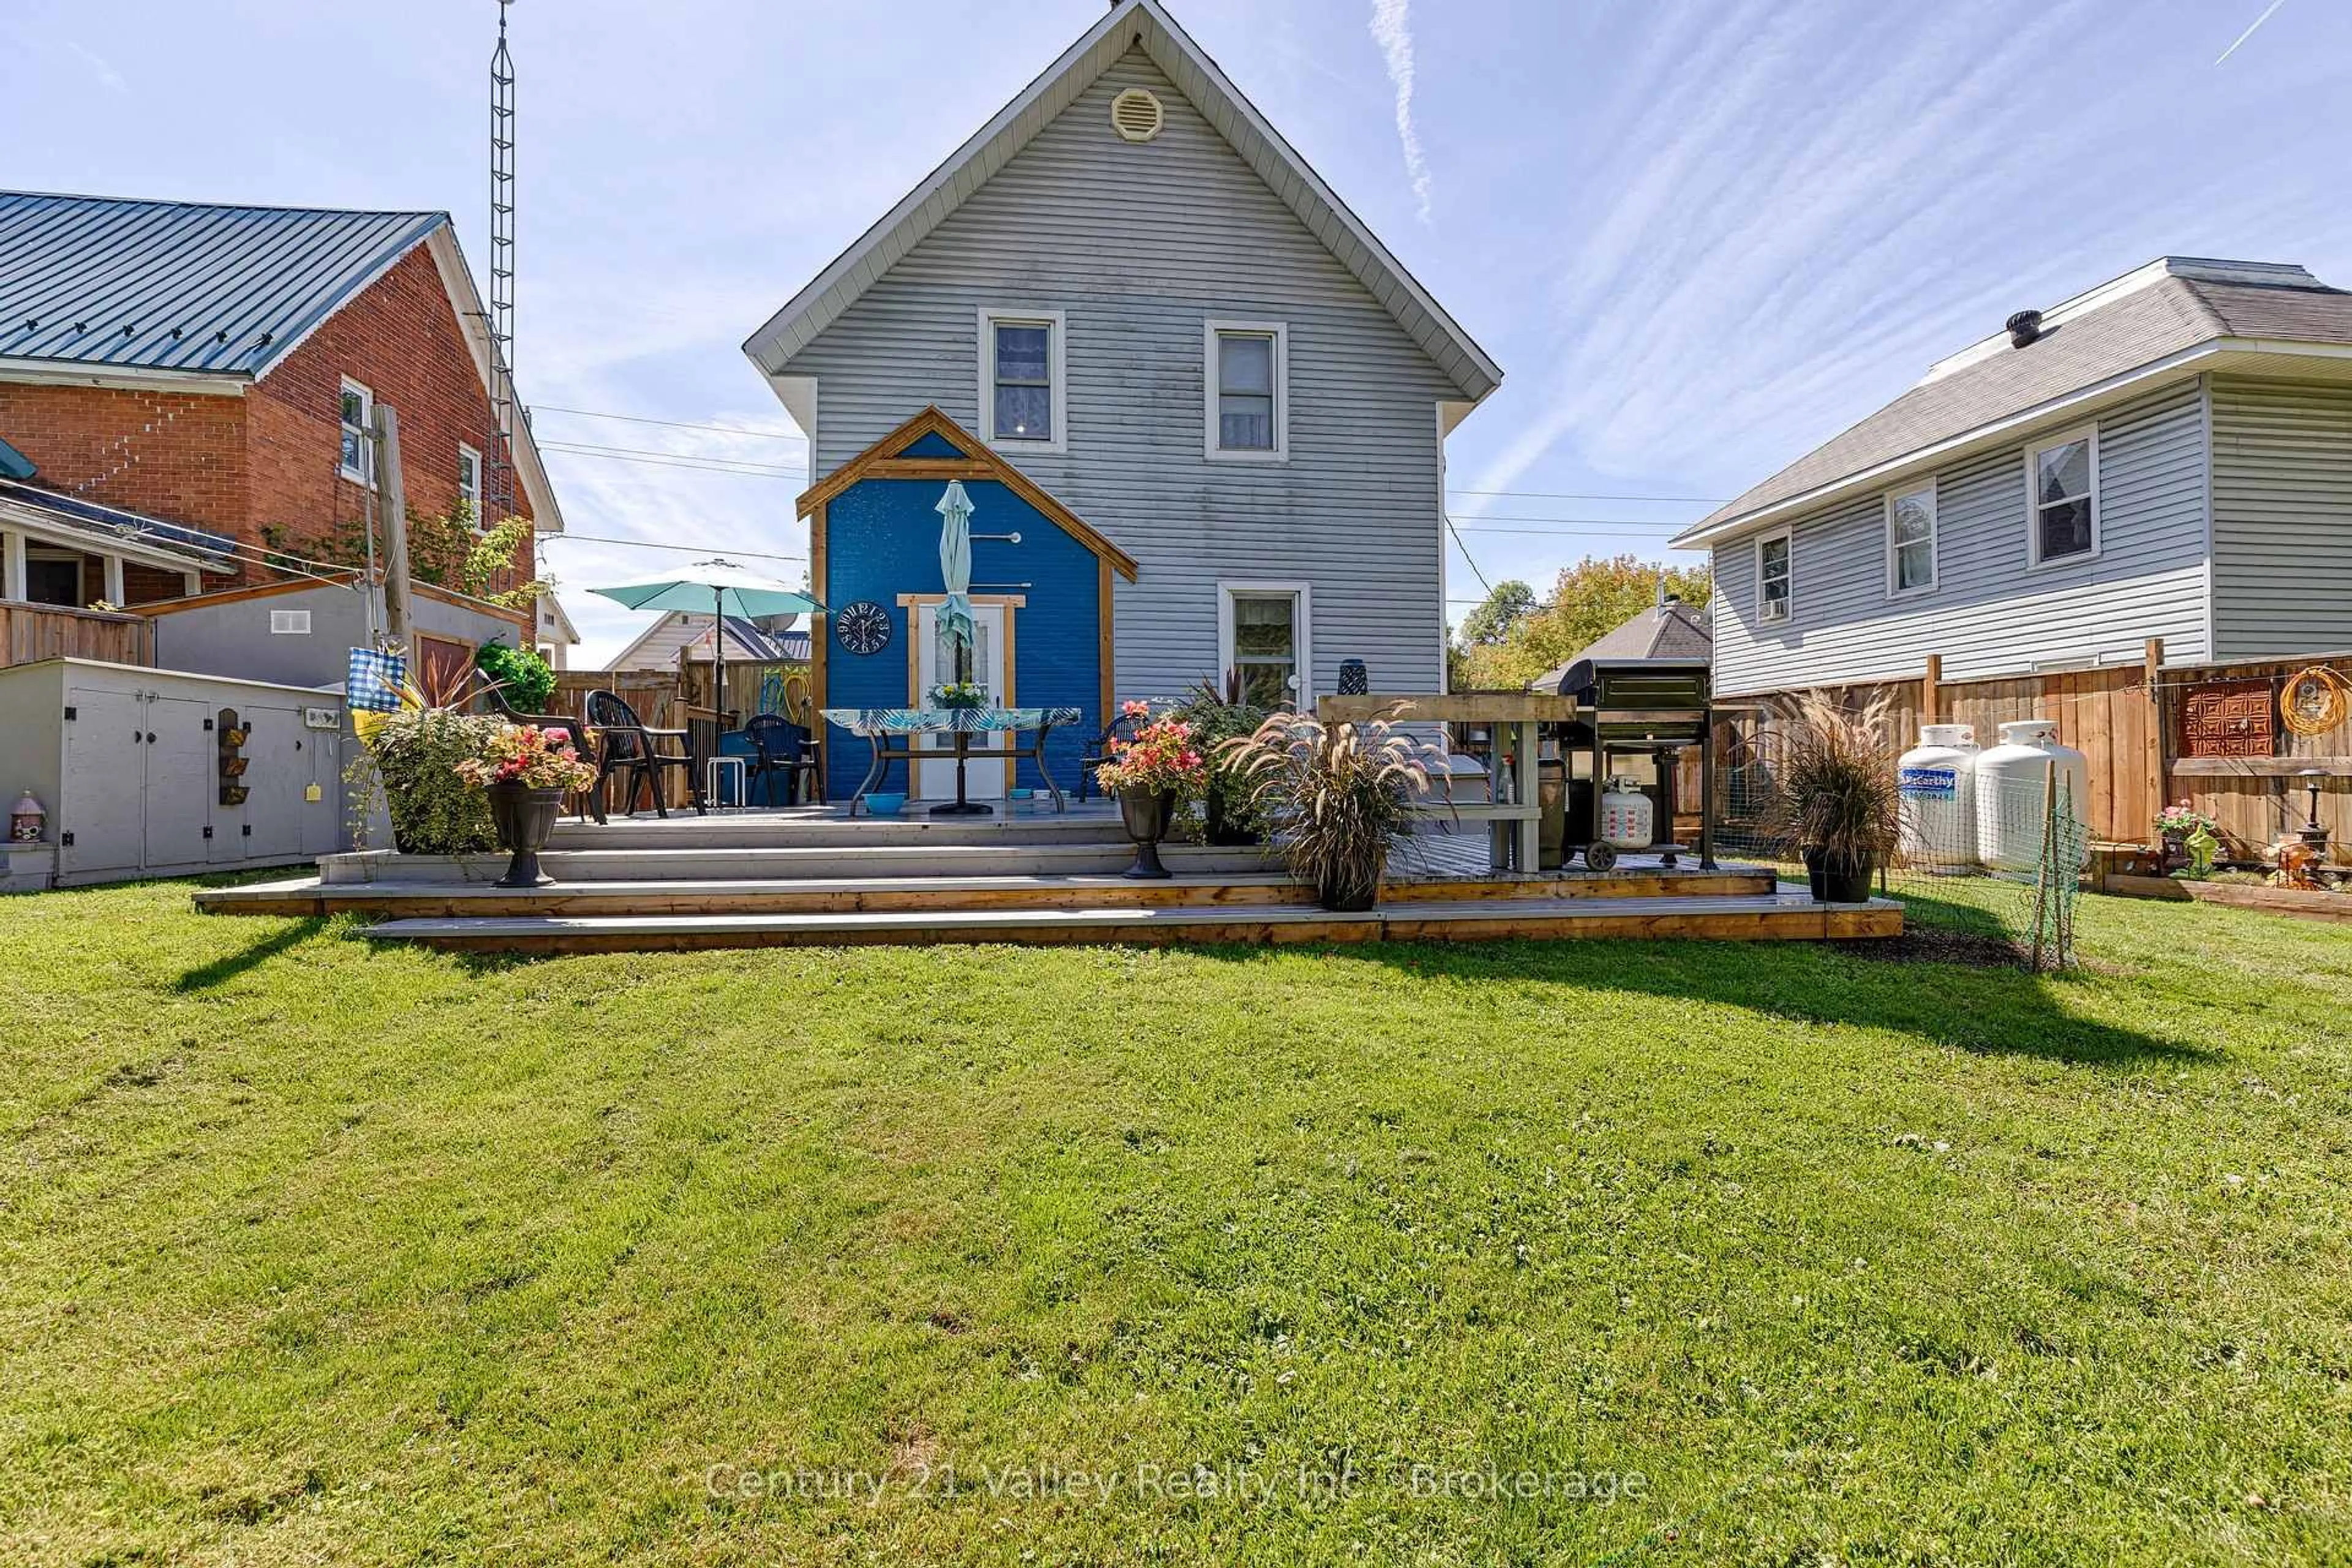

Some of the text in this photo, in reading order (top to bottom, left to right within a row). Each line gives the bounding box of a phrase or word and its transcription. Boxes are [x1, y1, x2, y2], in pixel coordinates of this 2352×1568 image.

[858, 603, 869, 614] 12
[851, 639, 859, 651] 7
[861, 641, 869, 653] 6
